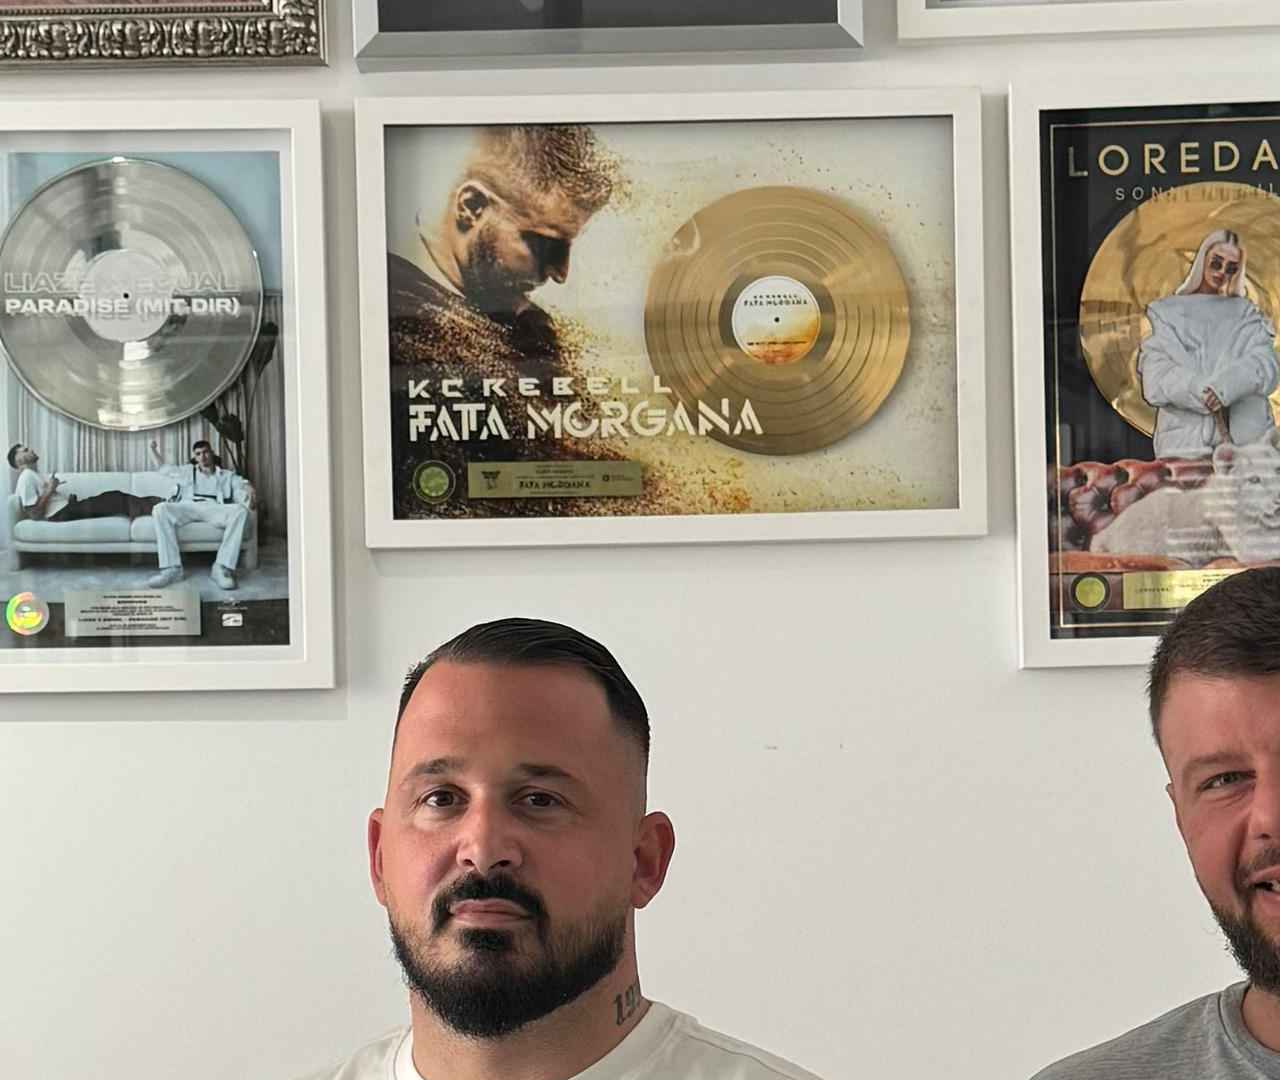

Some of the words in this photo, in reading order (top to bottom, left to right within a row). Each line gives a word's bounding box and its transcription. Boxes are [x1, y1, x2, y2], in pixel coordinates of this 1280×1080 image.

[5, 297, 129, 315] PARADISE
[408, 379, 463, 399] KC
[482, 375, 672, 397] REBELL
[408, 403, 511, 441] FATA
[526, 398, 764, 439] MORGANA
